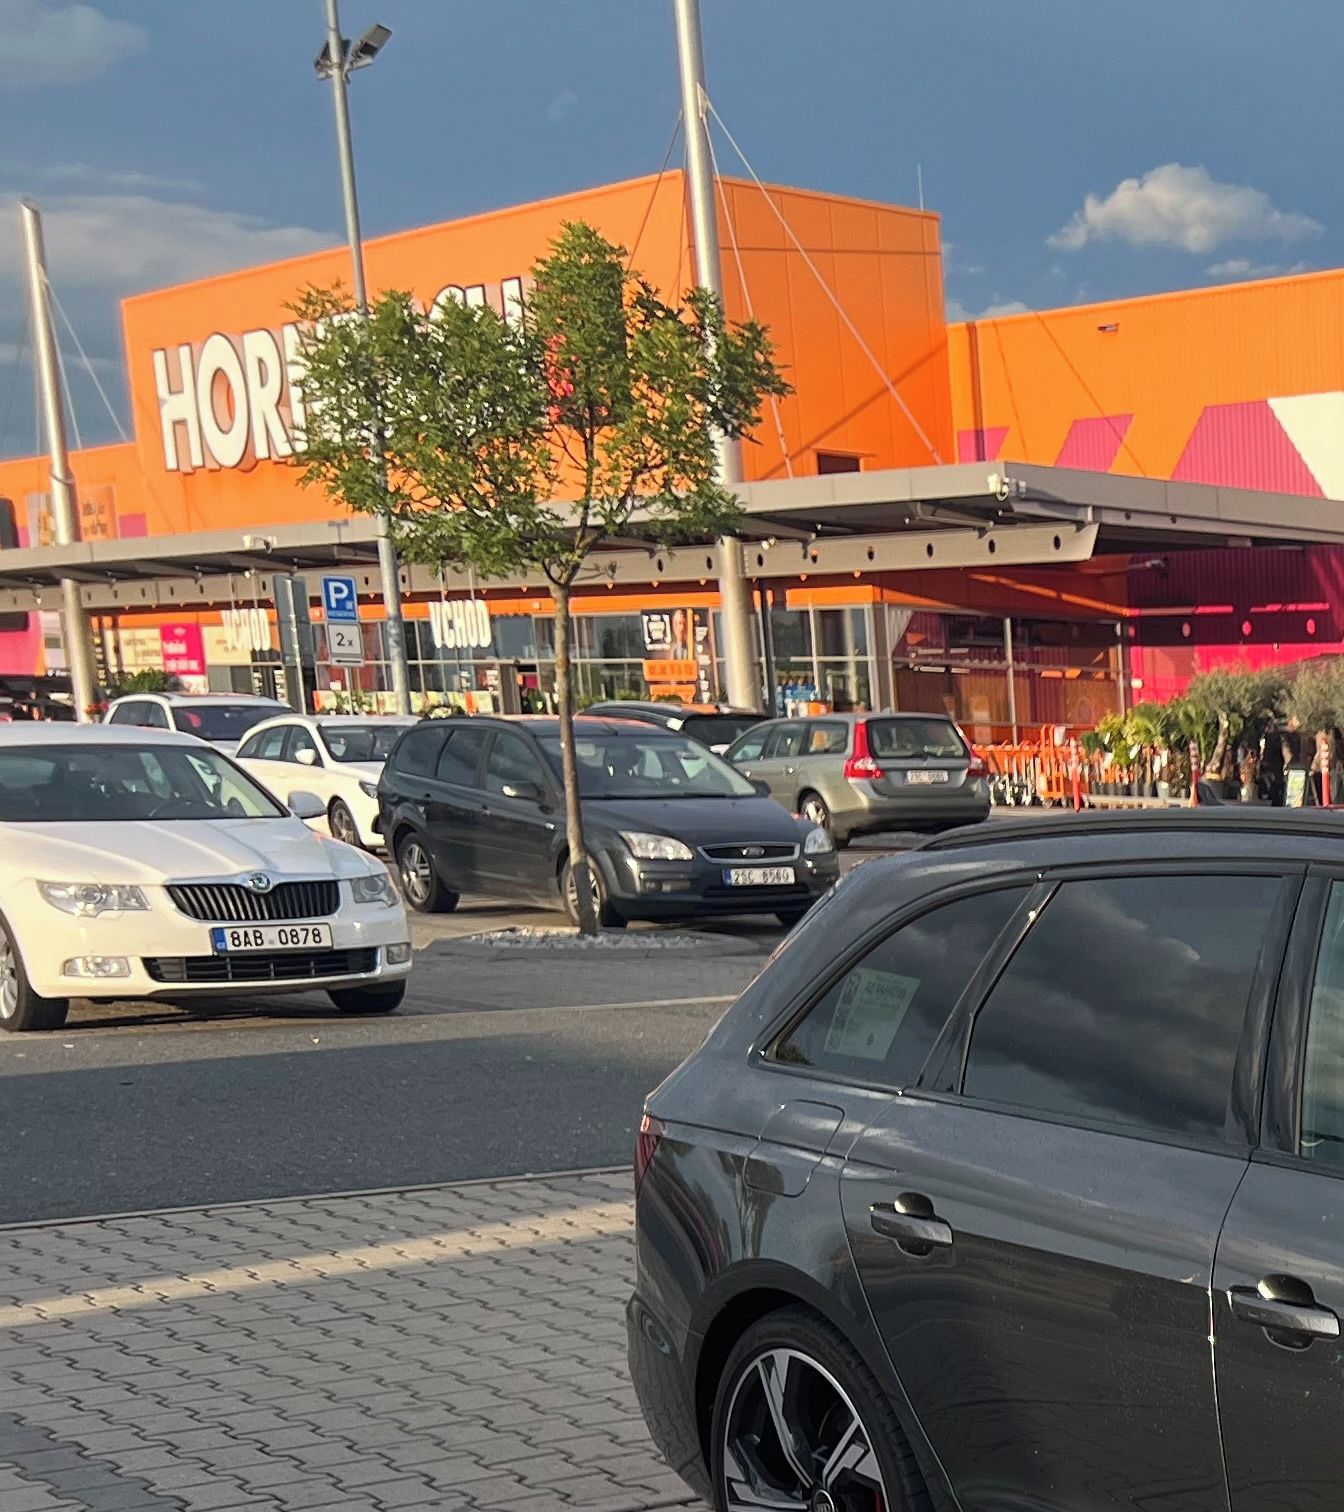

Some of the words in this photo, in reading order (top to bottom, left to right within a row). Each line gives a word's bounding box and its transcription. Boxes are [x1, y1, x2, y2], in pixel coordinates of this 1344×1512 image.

[327, 581, 349, 609] P
[219, 607, 272, 651] VCHOD
[428, 599, 492, 649] VCHOD
[230, 929, 265, 948] 8AB
[277, 927, 323, 946] 0878
